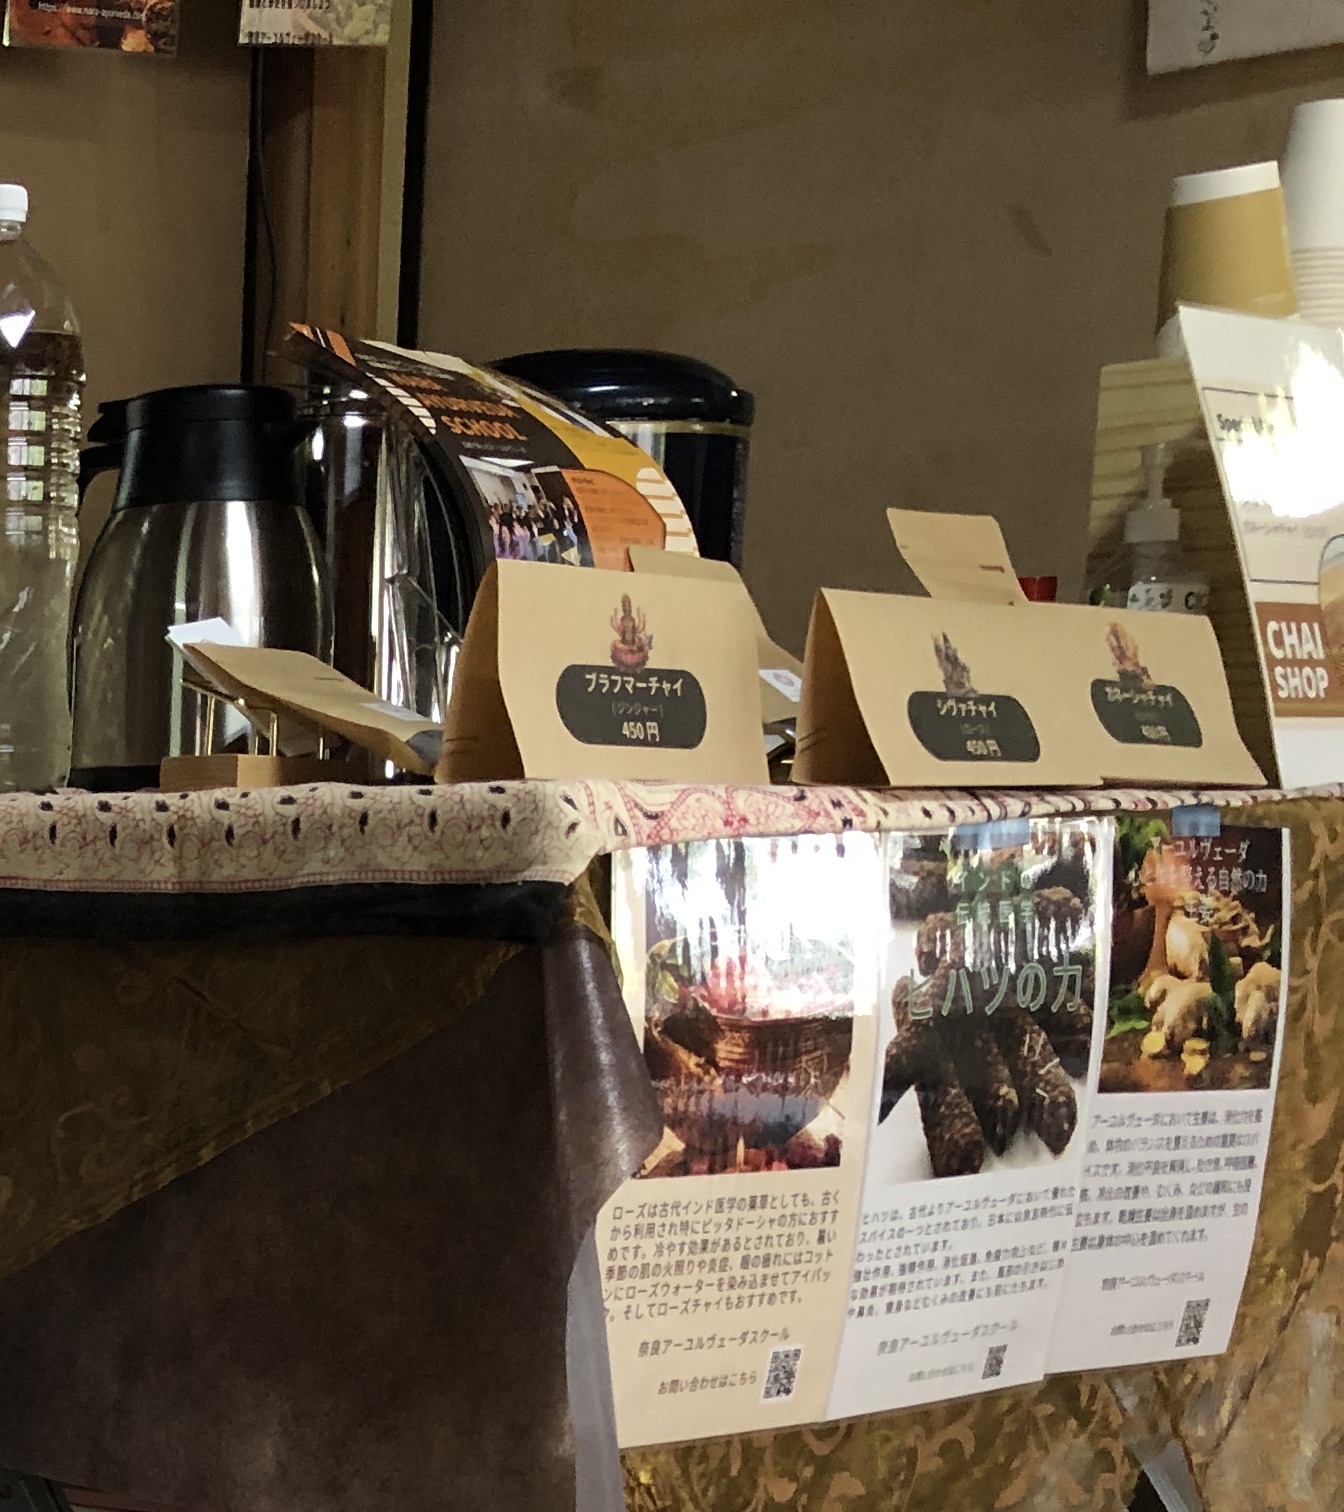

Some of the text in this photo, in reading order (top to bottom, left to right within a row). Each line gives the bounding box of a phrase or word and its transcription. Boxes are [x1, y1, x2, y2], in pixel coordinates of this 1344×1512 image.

[440, 415, 528, 441] SCHOOL
[1267, 620, 1325, 661] CHAI
[585, 672, 683, 697] ブラフマーチャイ
[1274, 665, 1329, 699] SHOP
[909, 951, 1083, 1020] ヒハツの力
[638, 1327, 790, 1358] 奈良アーユルヴェーダスクール
